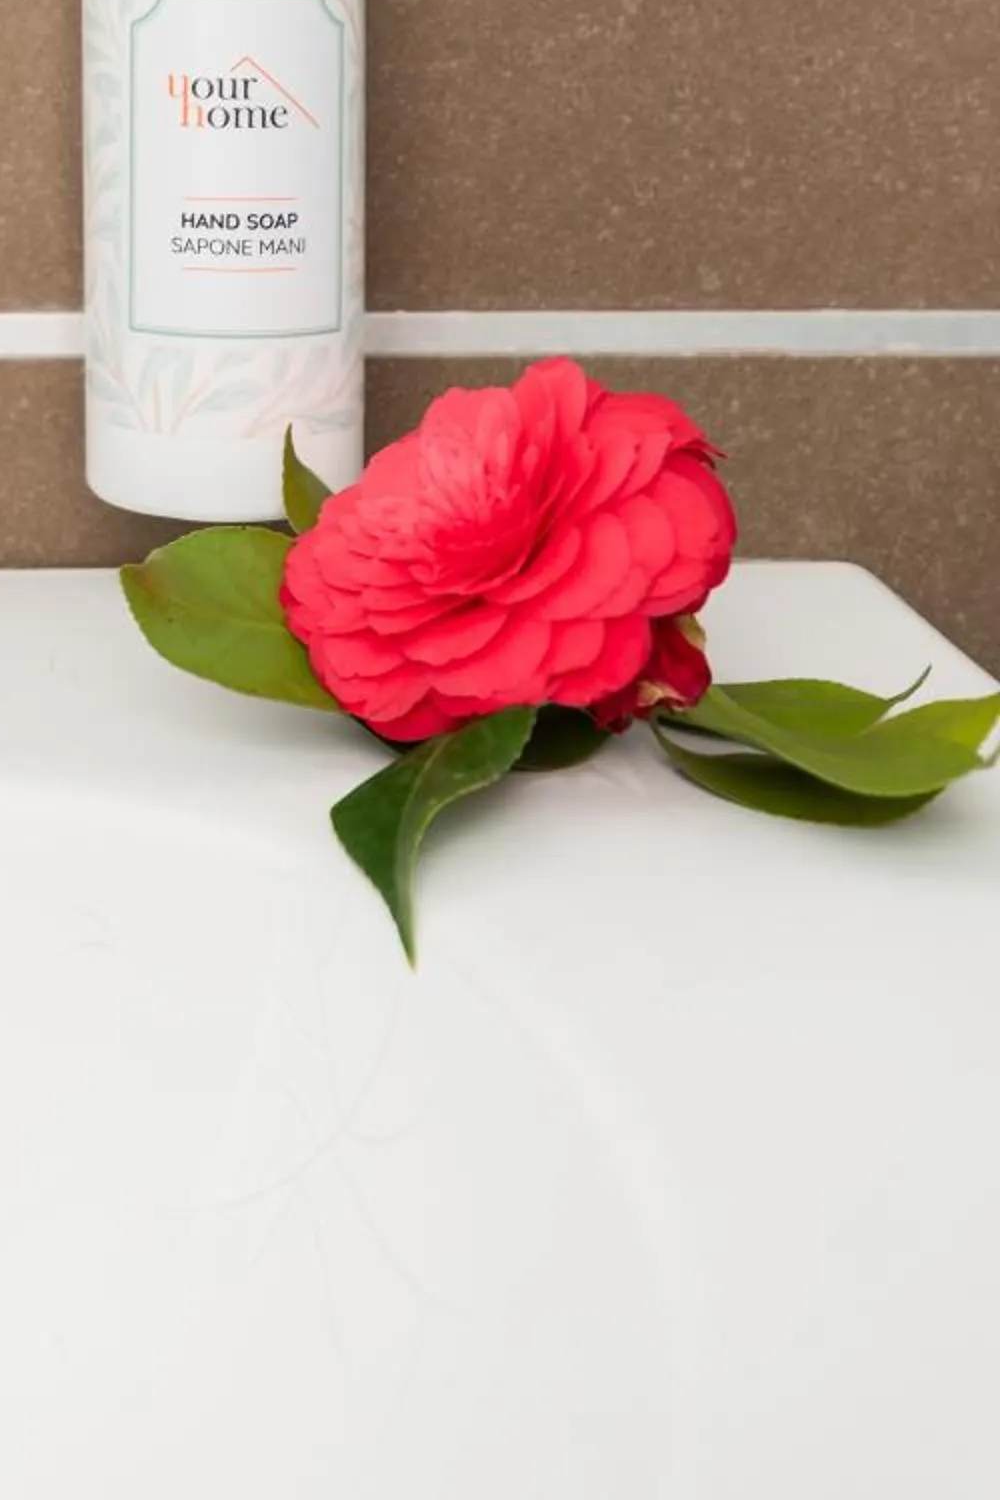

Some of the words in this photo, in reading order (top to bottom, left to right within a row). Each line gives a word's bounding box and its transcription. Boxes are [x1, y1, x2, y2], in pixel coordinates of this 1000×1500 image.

[167, 73, 258, 118] your
[180, 103, 289, 129] home
[180, 212, 240, 229] HAND
[246, 213, 299, 230] SOAP
[170, 236, 253, 256] SAPONE
[258, 238, 306, 255] MANI
